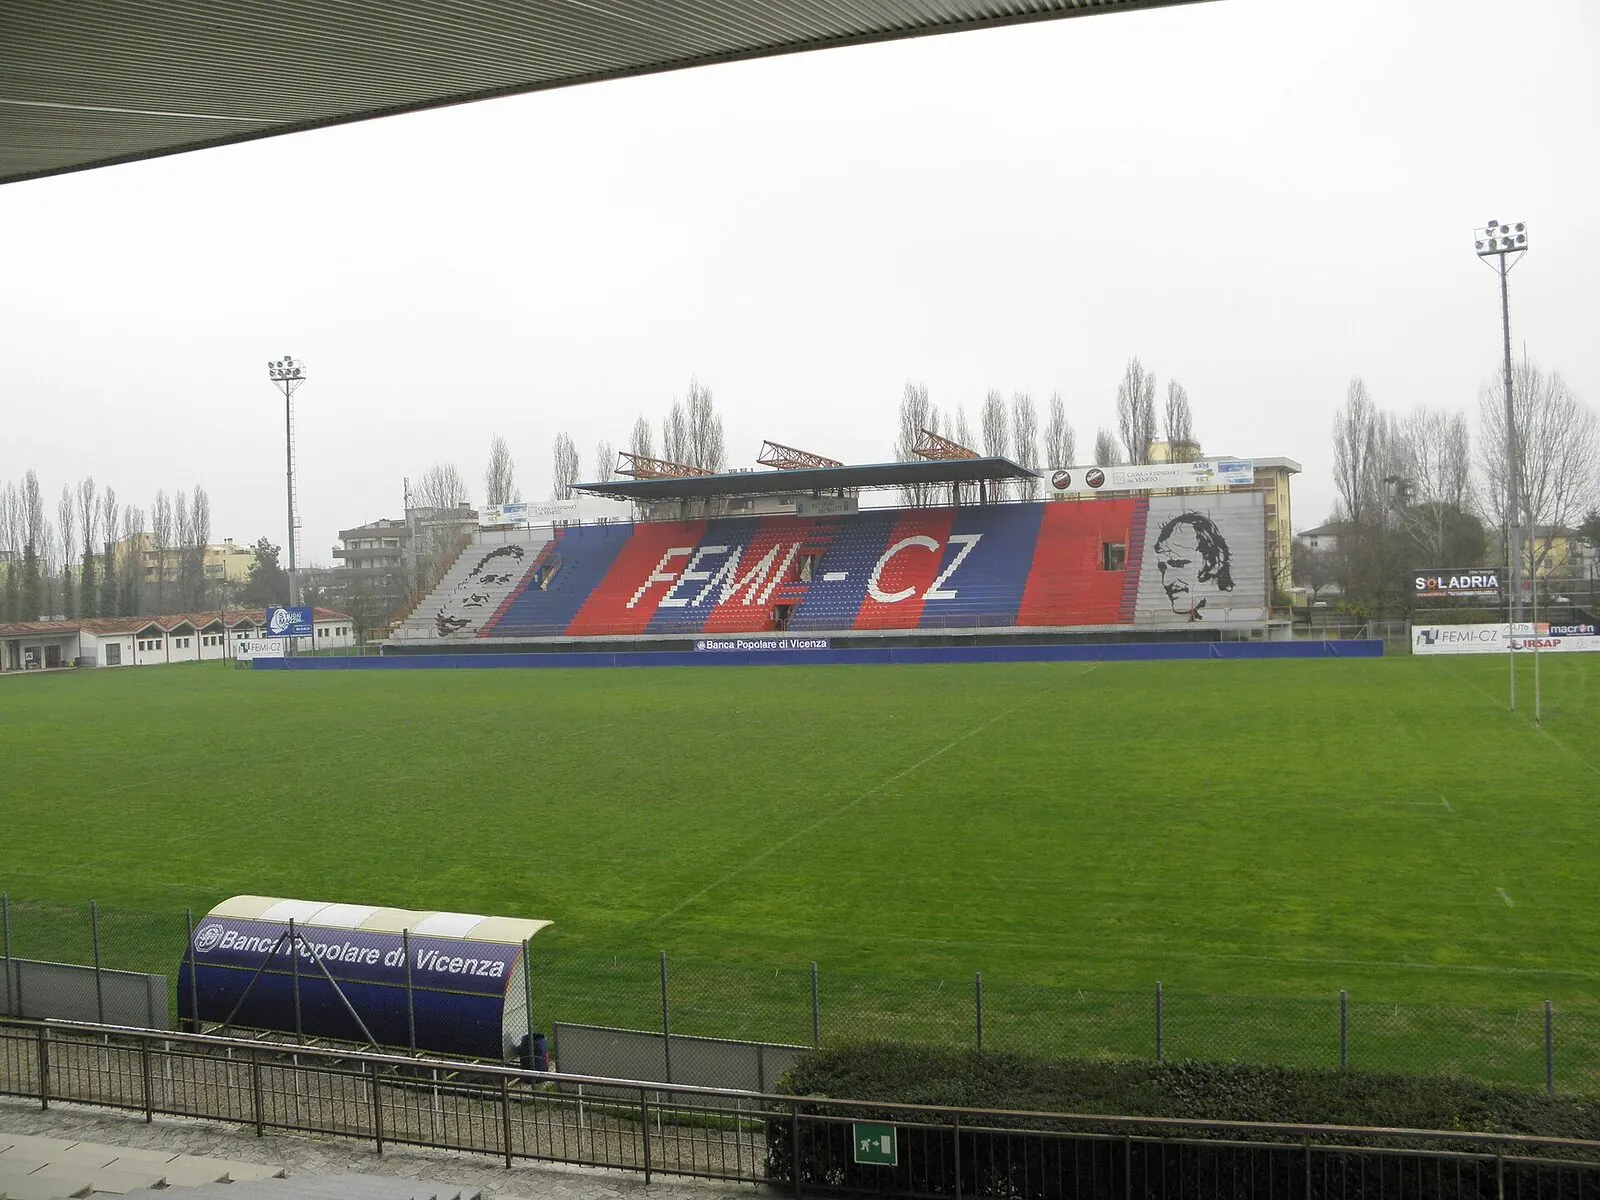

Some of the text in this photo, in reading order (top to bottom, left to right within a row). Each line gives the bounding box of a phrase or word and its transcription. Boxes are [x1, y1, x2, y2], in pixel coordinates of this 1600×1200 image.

[1415, 575, 1498, 590] SOLADRIA
[1550, 624, 1594, 634] macron
[1442, 629, 1498, 643] FEMI-CZ
[251, 640, 281, 652] FEMI-CZ
[706, 638, 827, 651] Banca Popolare di Vicenza
[1523, 639, 1562, 648] IRSAP
[384, 946, 406, 968] di
[416, 949, 505, 977] Vicenza
